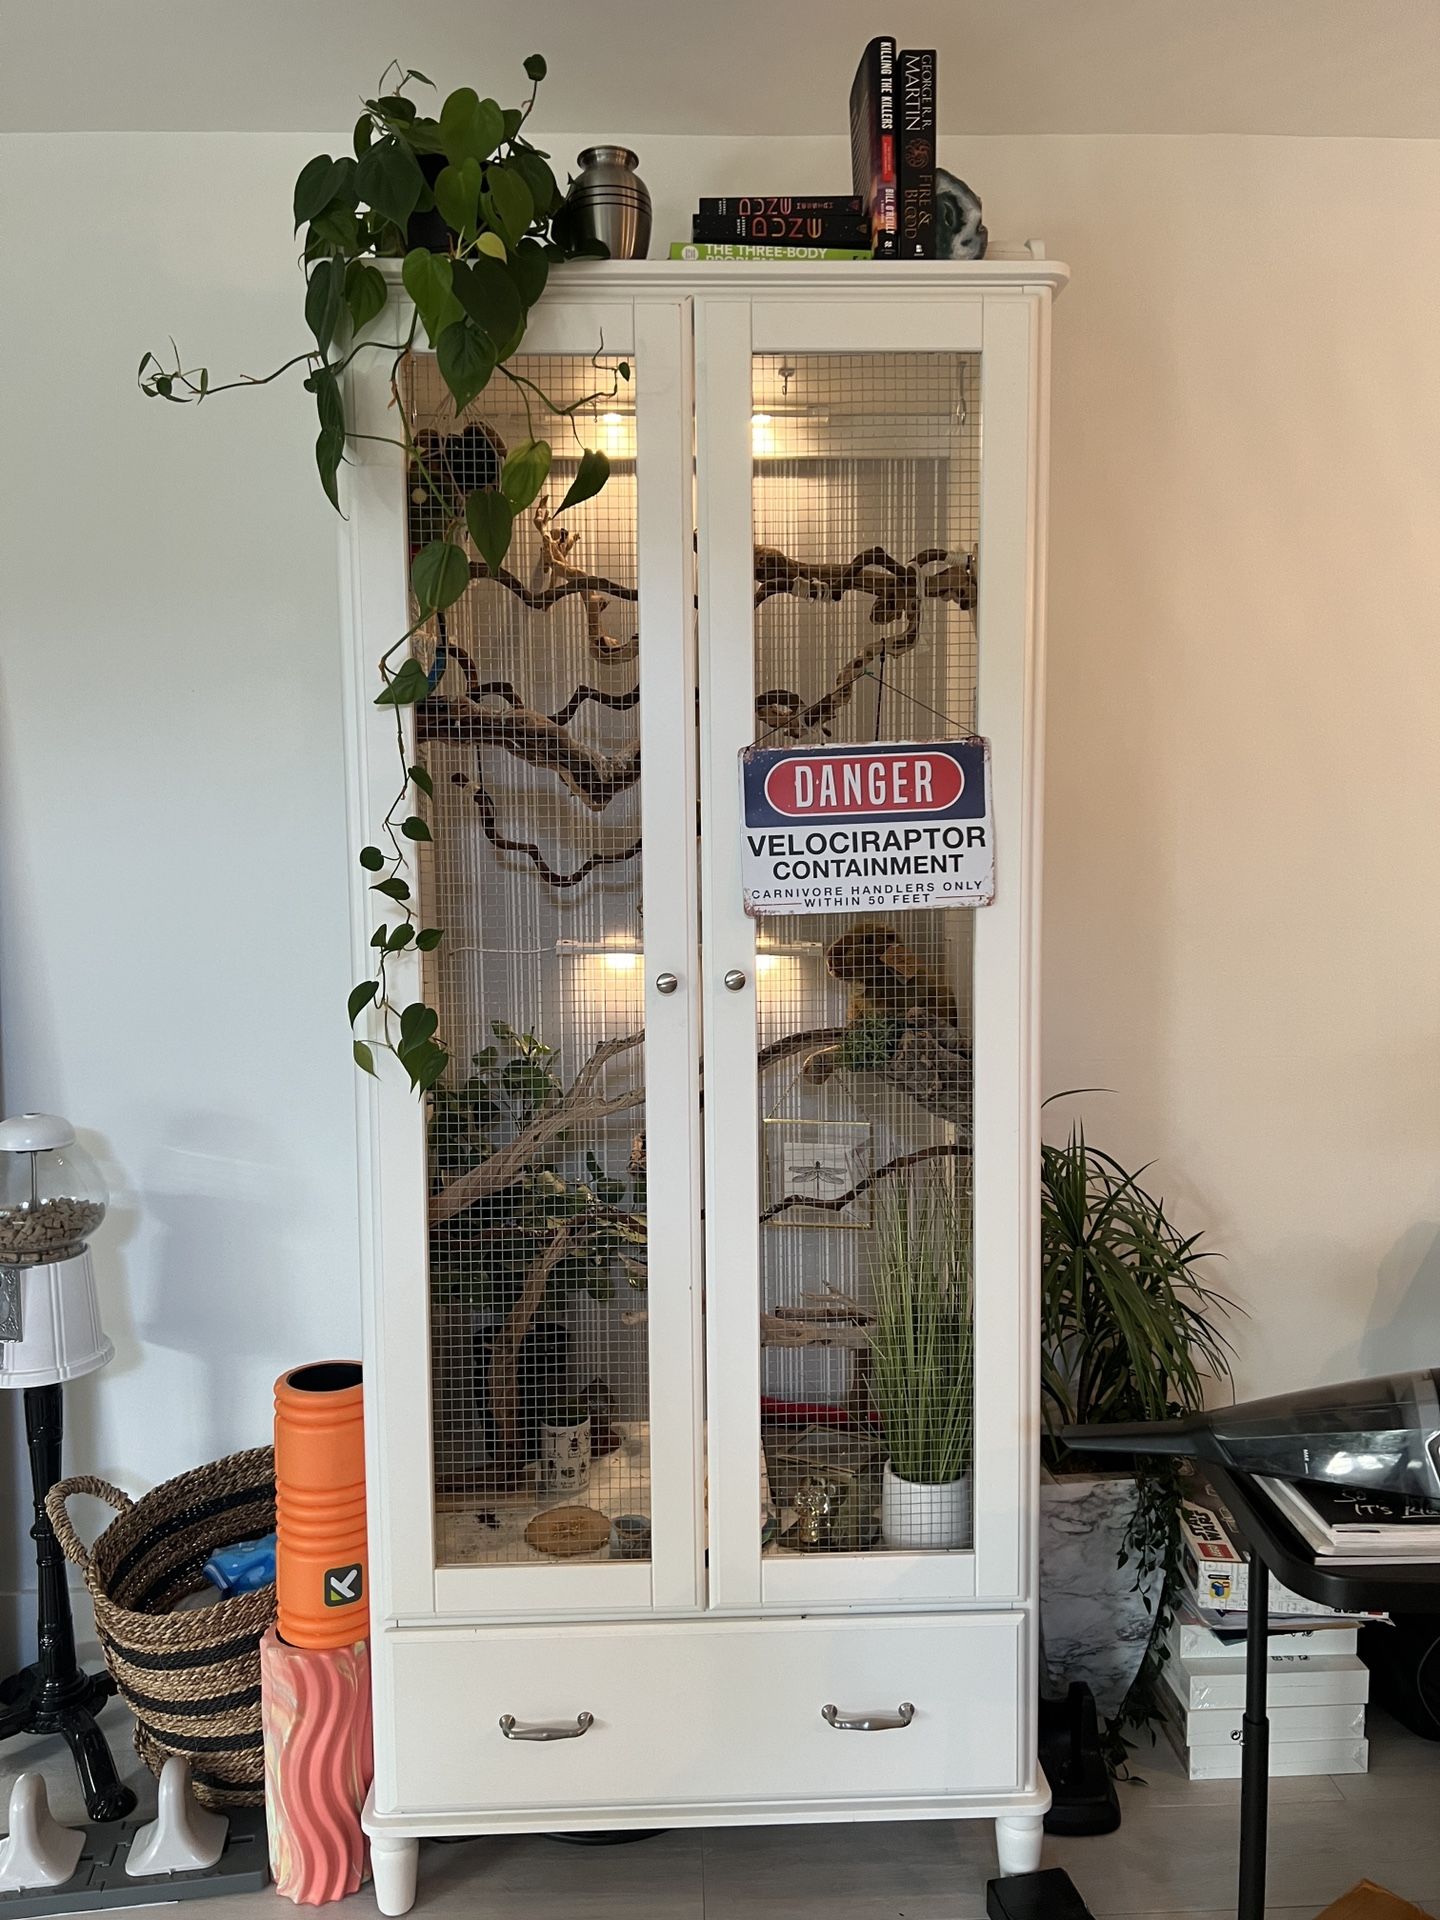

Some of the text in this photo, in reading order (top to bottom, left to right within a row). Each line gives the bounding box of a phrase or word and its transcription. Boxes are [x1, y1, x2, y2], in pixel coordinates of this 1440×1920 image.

[881, 41, 892, 75] KILLING
[881, 78, 893, 94] THE
[905, 55, 920, 131] MARTIN
[921, 54, 933, 103] GEORGE
[881, 96, 893, 129] KILLERS
[885, 188, 895, 203] BILL
[919, 174, 932, 207] FIRE
[905, 189, 918, 239] BLOOD
[704, 243, 828, 259] THE THREE-BODY
[794, 760, 934, 808] DANGER
[747, 826, 987, 857] VELOCIRAPTOR
[773, 854, 964, 881] CONTAINMENT
[751, 880, 983, 900] CARNIVORE HANDLERS ONLY
[804, 893, 930, 908] WITHIN 50 FEET
